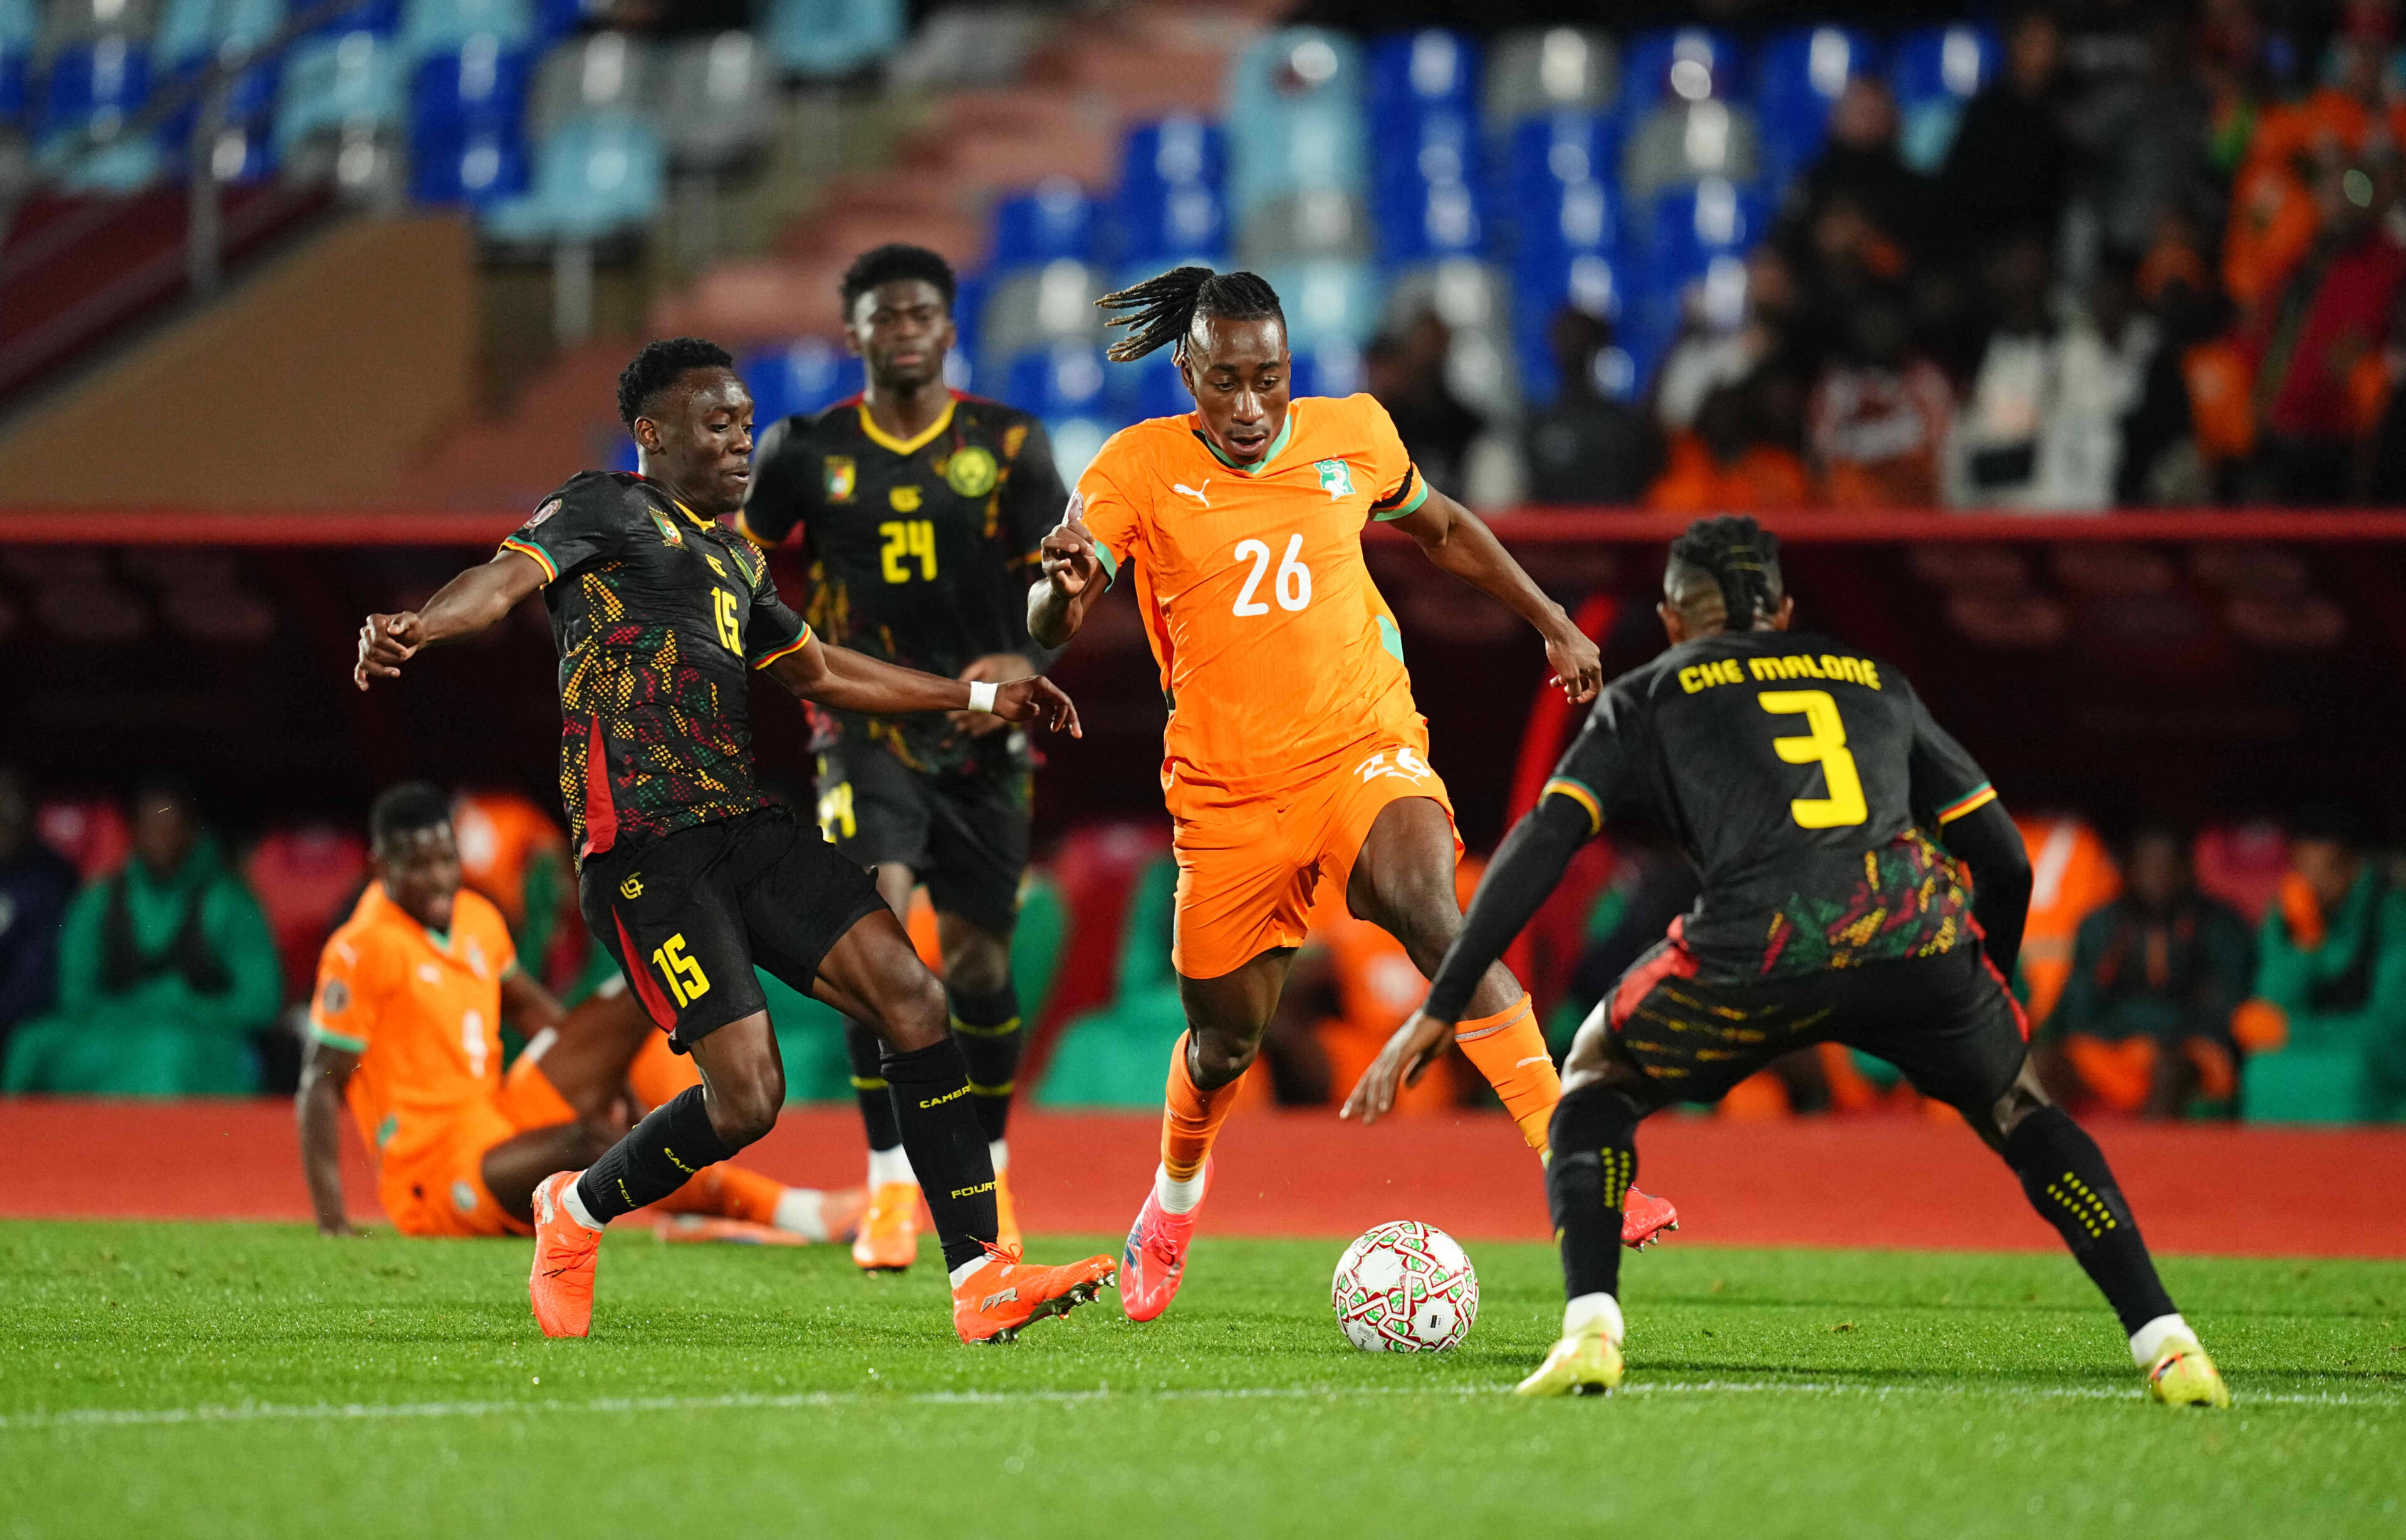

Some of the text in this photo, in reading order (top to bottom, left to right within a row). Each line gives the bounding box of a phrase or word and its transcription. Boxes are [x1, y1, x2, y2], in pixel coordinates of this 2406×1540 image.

[879, 519, 937, 584] 24
[1232, 533, 1312, 617] 26
[711, 586, 743, 657] 15
[1678, 654, 1882, 694] CHE MALONE
[1354, 747, 1431, 784] 26
[1757, 690, 1868, 830] 3
[652, 932, 711, 1009] 15
